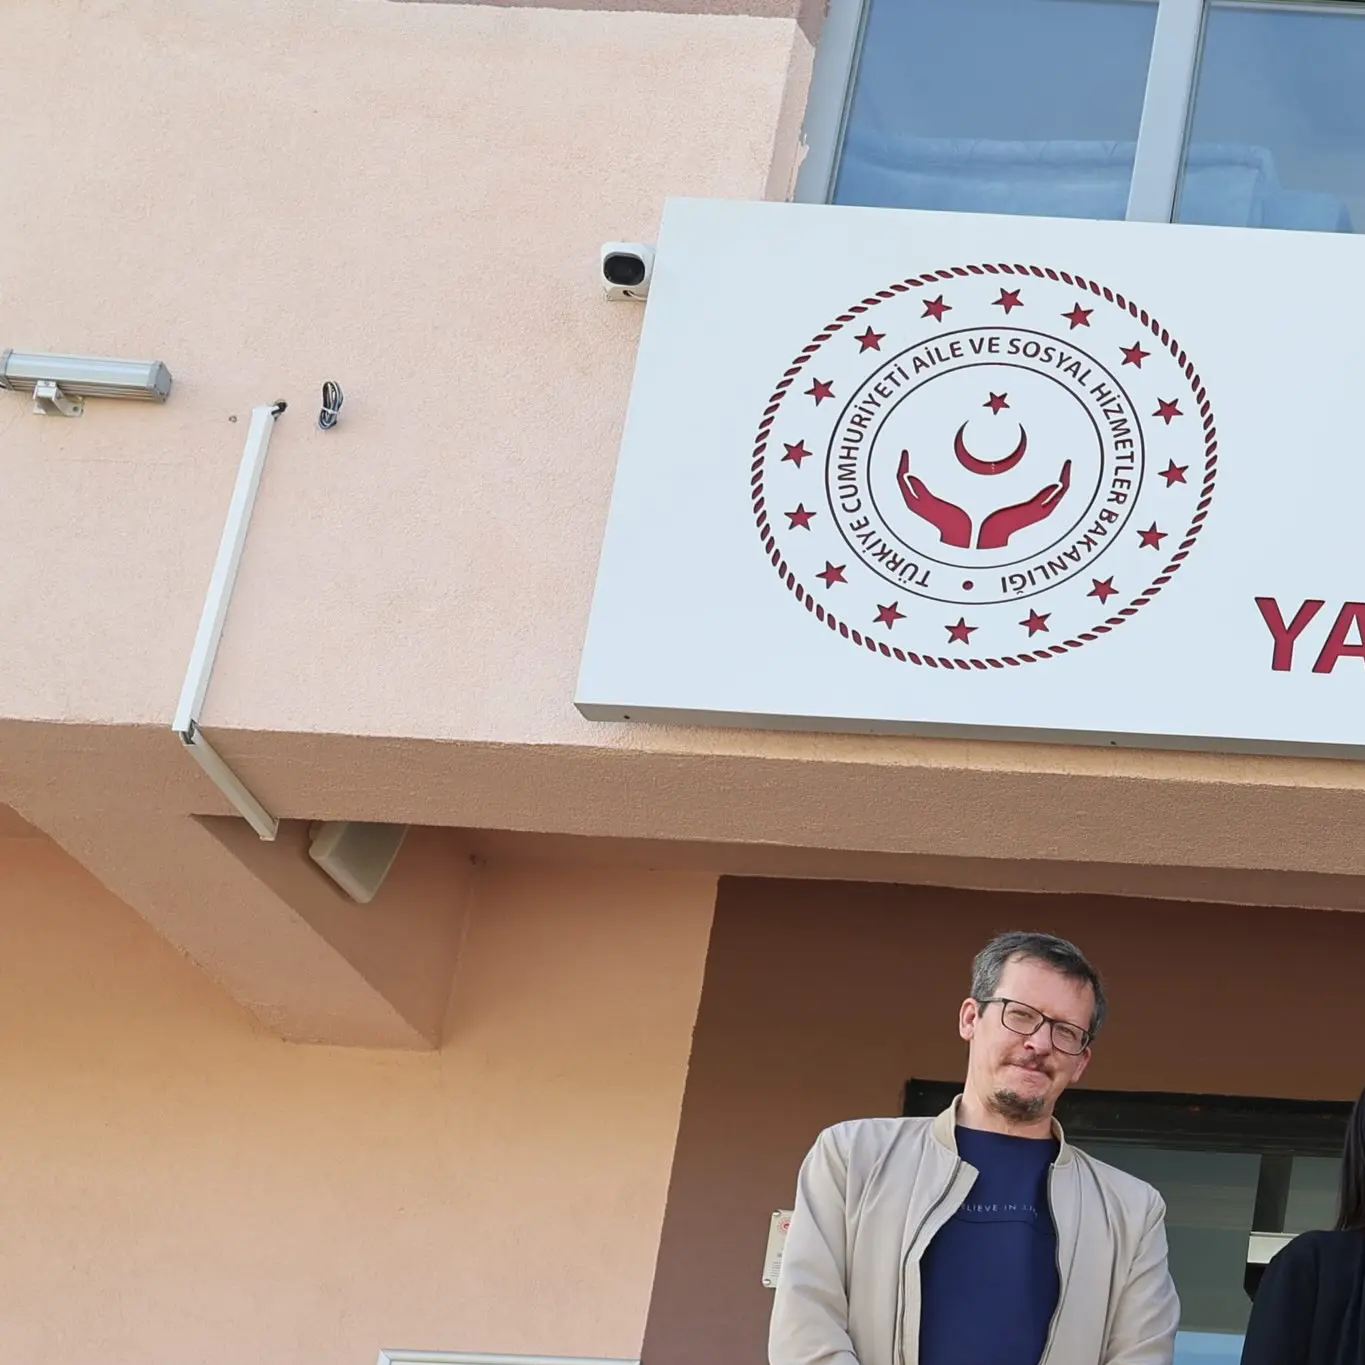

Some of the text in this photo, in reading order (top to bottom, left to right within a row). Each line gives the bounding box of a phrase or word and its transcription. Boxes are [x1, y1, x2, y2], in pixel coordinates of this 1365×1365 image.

[837, 336, 1134, 595] TÜRKİYE CUMHURİYETİ AİLE VE SOSYAL HİZMETLER BAKANLIĞI
[962, 1203, 999, 1213] LIEVE
[1004, 1203, 1017, 1211] IN
